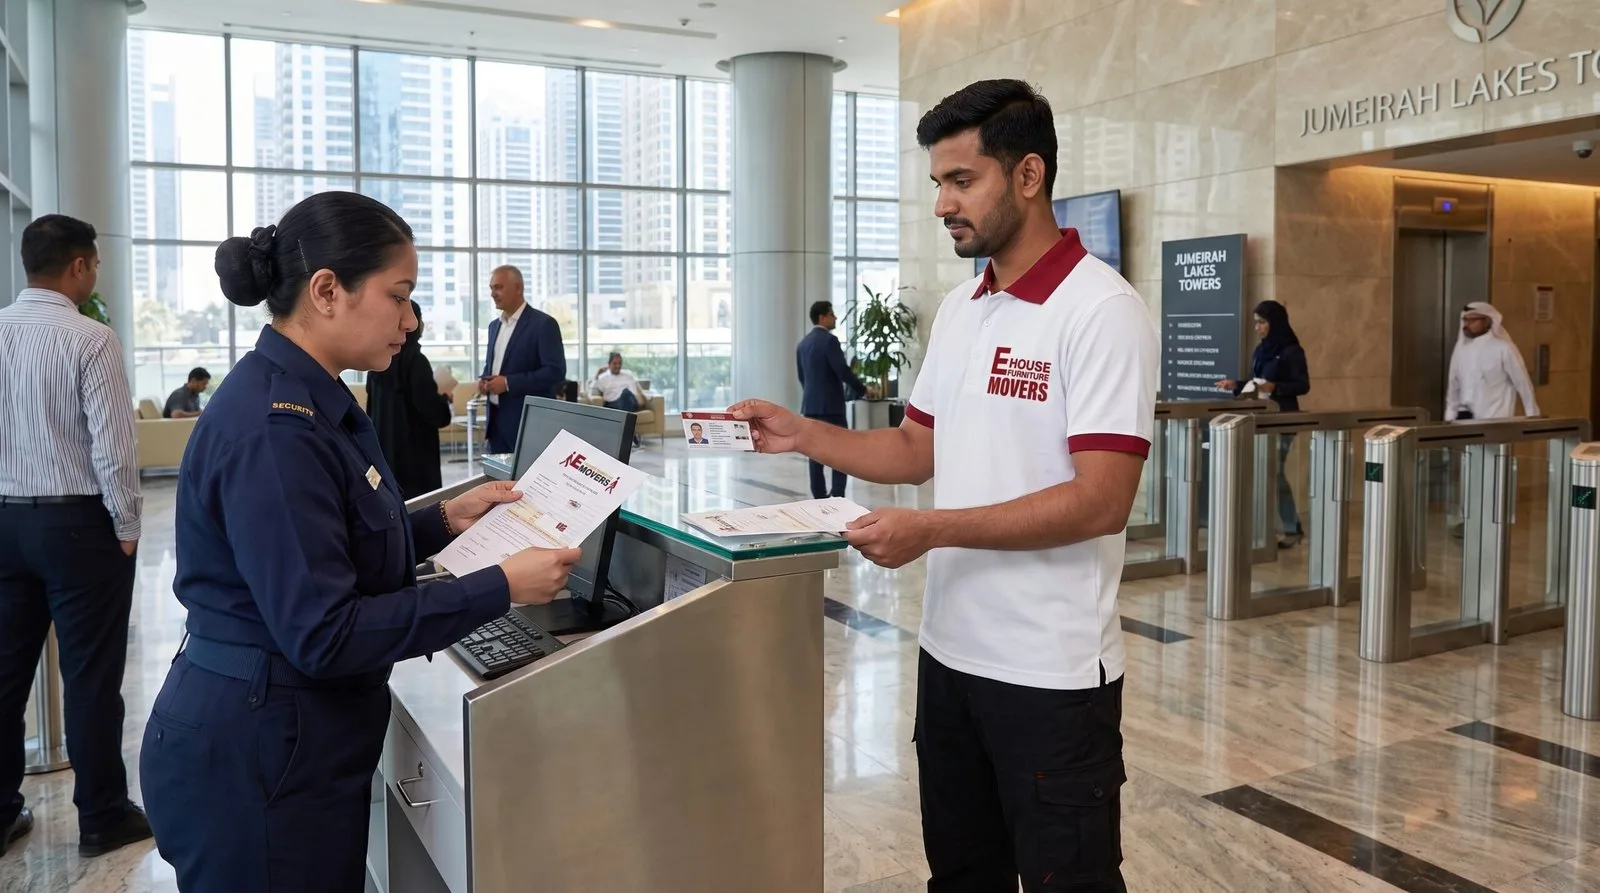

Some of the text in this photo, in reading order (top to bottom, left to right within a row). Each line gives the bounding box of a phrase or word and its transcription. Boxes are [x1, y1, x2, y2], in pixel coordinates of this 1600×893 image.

[1300, 48, 1600, 137] JUMEIRAH LAKES T
[1174, 250, 1227, 266] JUMEIRAH
[1183, 264, 1217, 278] LAKES
[1178, 277, 1222, 291] TOWERS
[991, 346, 1052, 375] E HOUSE
[1007, 369, 1050, 382] FURNITURE
[987, 376, 1049, 402] MOVERS
[272, 402, 314, 417] SECURITY
[569, 453, 587, 470] E
[577, 464, 611, 487] MOVERS
